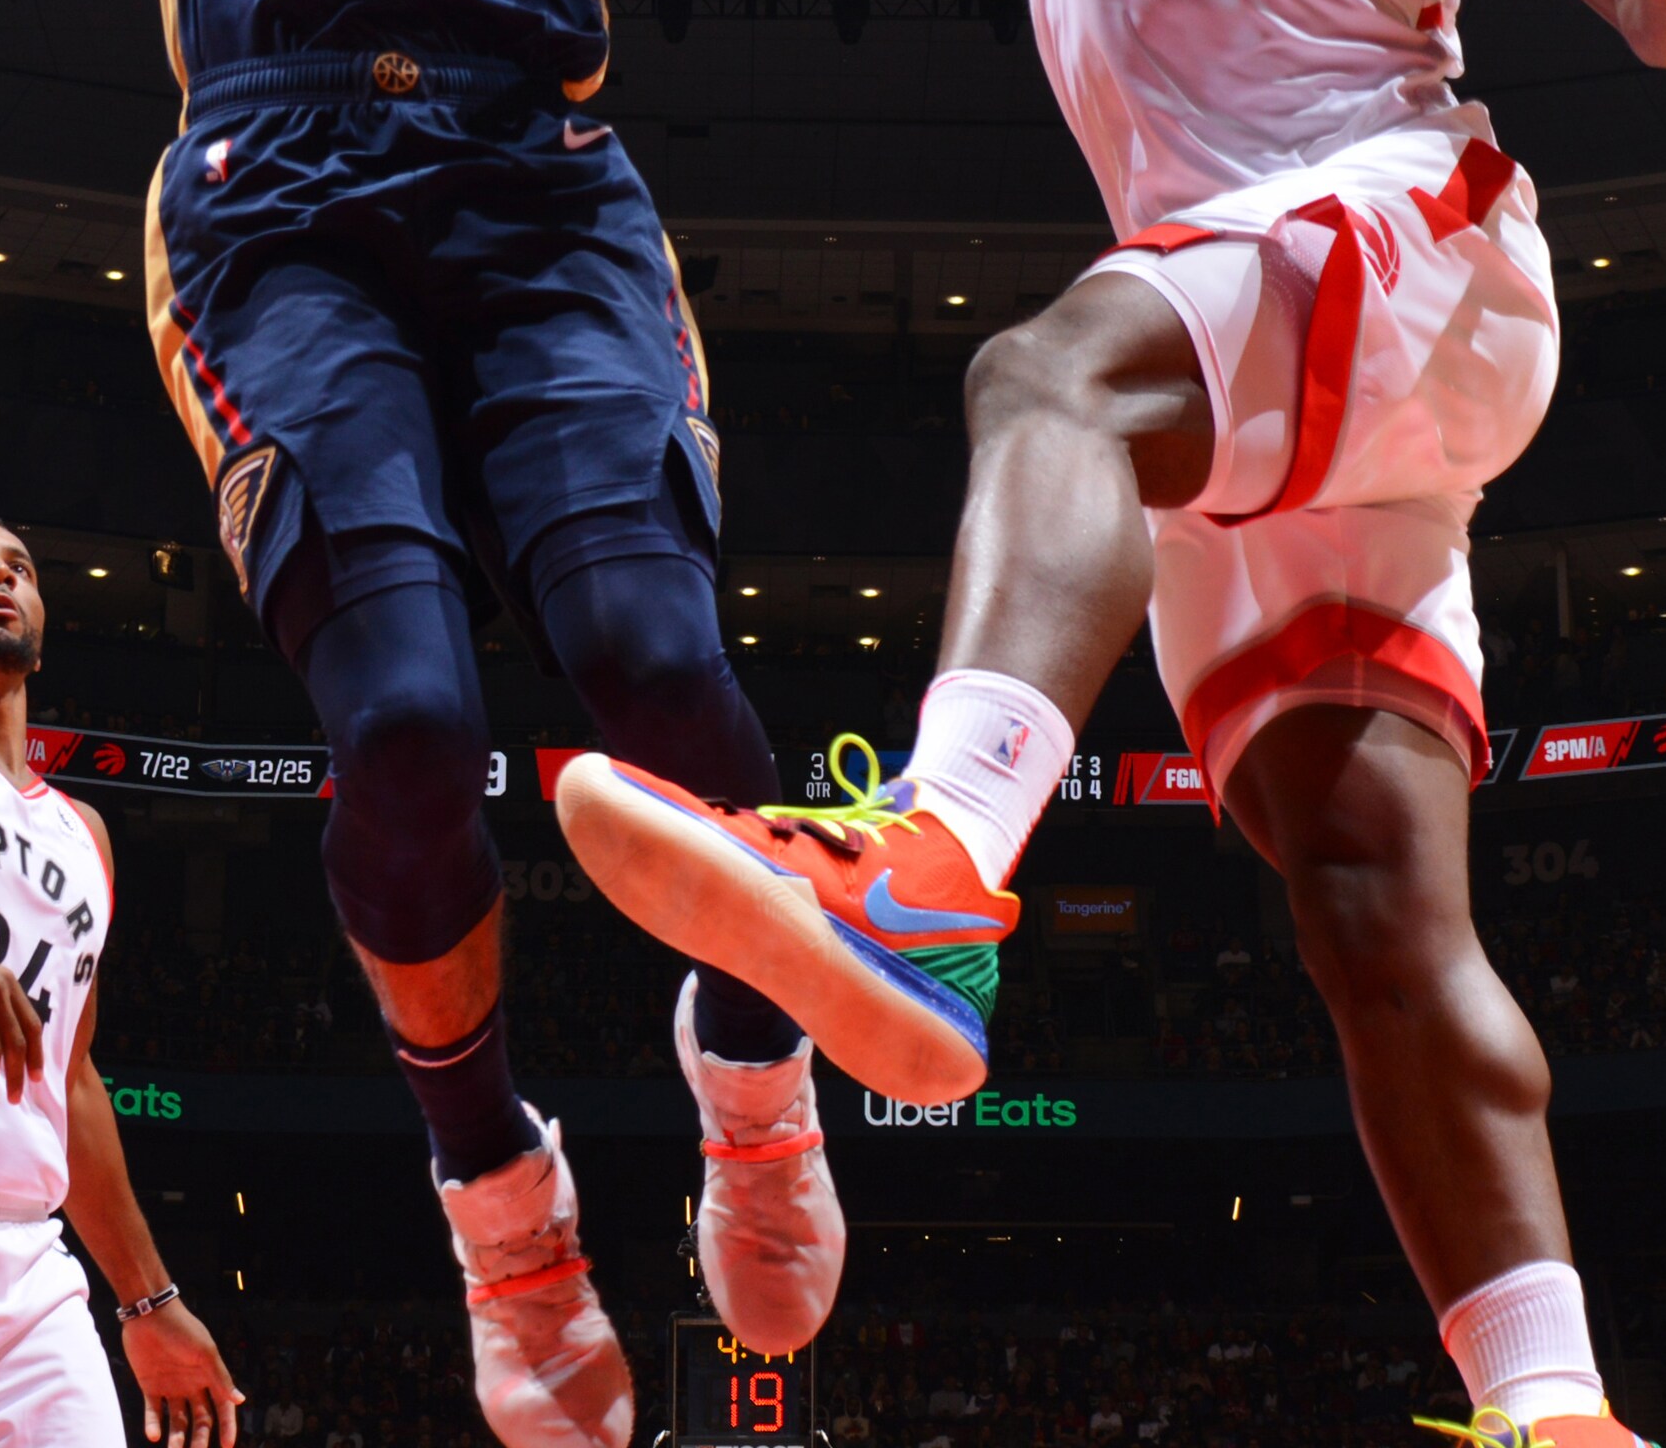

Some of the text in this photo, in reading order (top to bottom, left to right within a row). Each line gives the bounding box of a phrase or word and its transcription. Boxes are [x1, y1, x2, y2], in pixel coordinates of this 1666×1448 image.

[1544, 736, 1607, 762] 3PM/A
[140, 751, 312, 785] 7/22 12/25
[810, 753, 825, 782] 3
[1089, 755, 1101, 776] 3
[806, 781, 831, 799] QTR
[1089, 779, 1102, 800] 4
[1501, 839, 1600, 886] 304
[1056, 899, 1125, 918] Tangerine
[864, 1091, 1077, 1127] Uber Eats
[730, 1371, 784, 1433] 19
